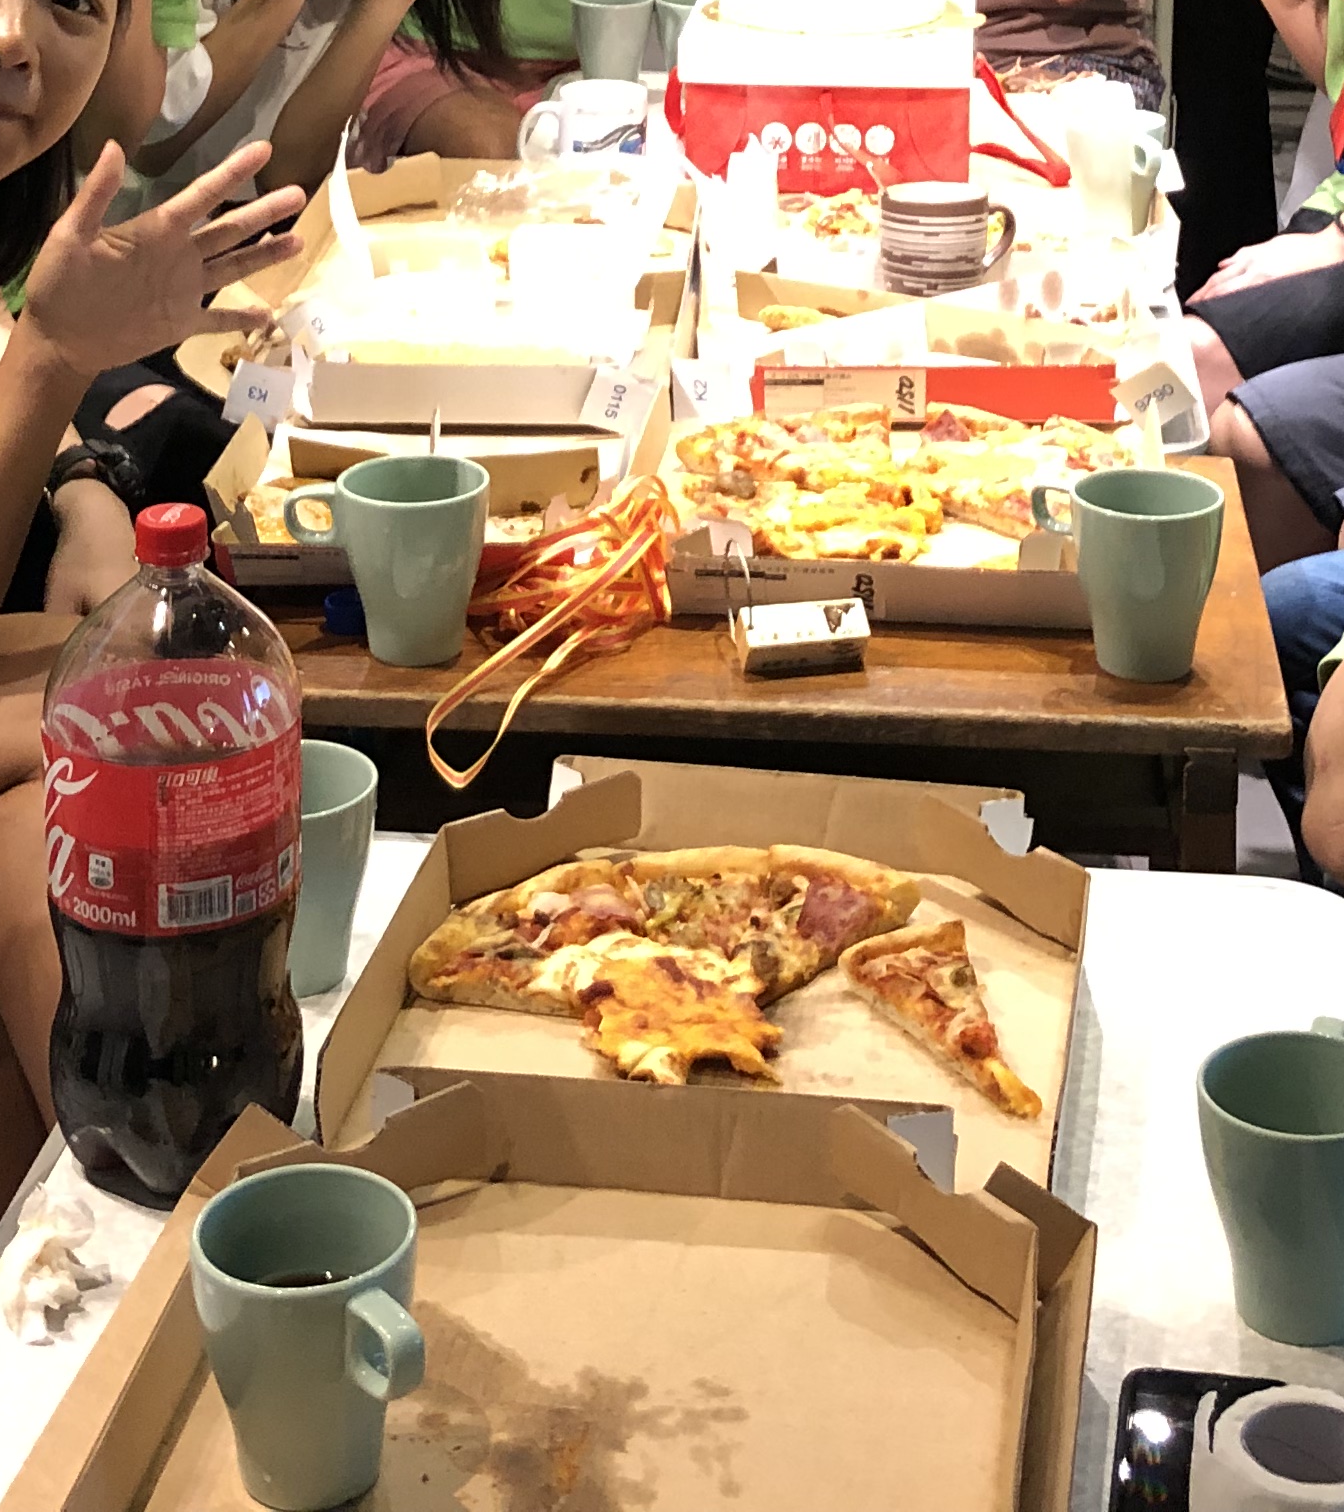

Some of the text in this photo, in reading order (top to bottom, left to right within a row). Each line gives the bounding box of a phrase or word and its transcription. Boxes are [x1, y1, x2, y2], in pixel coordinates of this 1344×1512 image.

[247, 385, 269, 403] K3
[603, 384, 628, 420] 0115
[693, 379, 708, 402] K2
[73, 896, 137, 928] 2000ml
